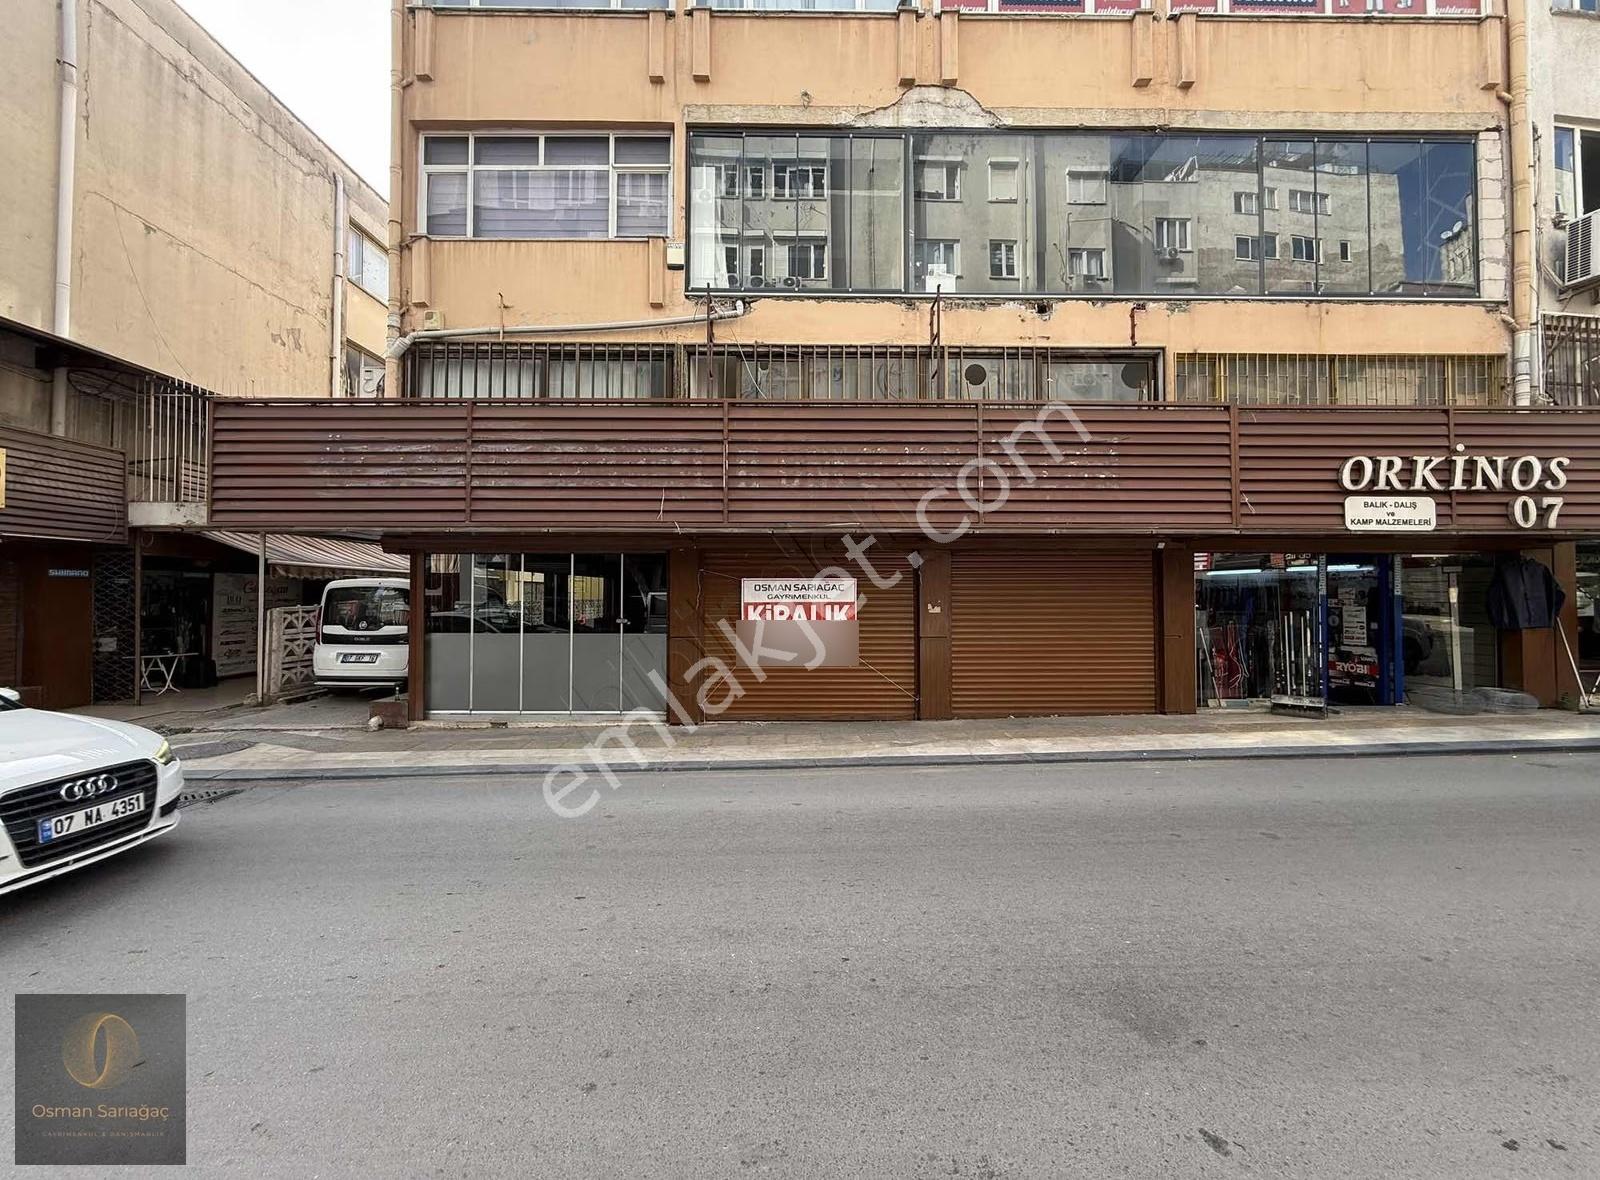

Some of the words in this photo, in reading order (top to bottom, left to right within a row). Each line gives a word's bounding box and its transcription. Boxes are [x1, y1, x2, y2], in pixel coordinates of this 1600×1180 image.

[1341, 443, 1571, 491] ORKİNOS
[1363, 501, 1389, 509] BALIK
[1394, 501, 1417, 510] DALIŞ
[1513, 495, 1564, 528] 07
[1350, 518, 1374, 526] KAMP
[1375, 517, 1432, 526] MALZEMELERİ
[754, 584, 792, 592] OSMAN
[1335, 661, 1369, 675] RYOBI
[54, 815, 75, 834] 07
[112, 795, 141, 817] 4351
